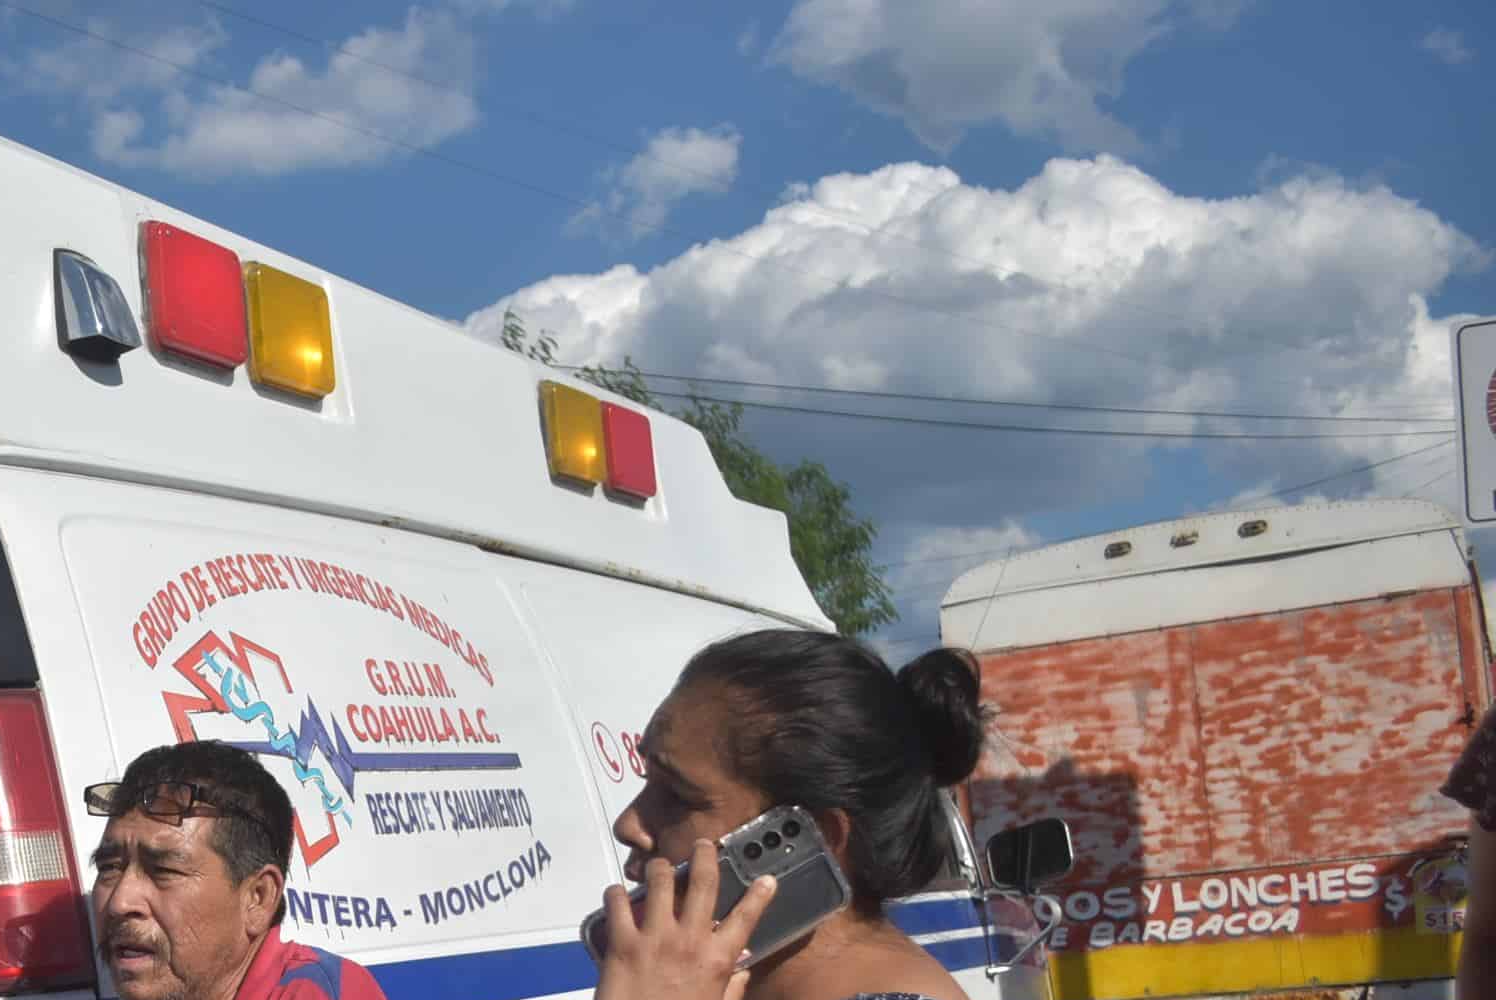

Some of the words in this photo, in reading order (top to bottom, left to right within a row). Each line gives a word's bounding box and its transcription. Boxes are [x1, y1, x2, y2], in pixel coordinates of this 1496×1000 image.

[133, 581, 191, 670] GRUPO
[180, 566, 217, 613] DE
[205, 553, 289, 600] RESCATE
[278, 555, 303, 590] Y
[294, 557, 405, 620] URGENCIAS
[400, 594, 494, 687] MEDICAS
[365, 658, 457, 698] G.R.U.M.
[346, 703, 461, 743] COAHUILA
[458, 708, 501, 744] A.C.
[365, 791, 435, 835] RESCATE
[430, 790, 447, 831] Y
[419, 839, 552, 926] MONCLOVA
[1142, 883, 1163, 914] Y
[1172, 863, 1380, 914] LONCHES
[1089, 907, 1302, 949] BARBACOA
